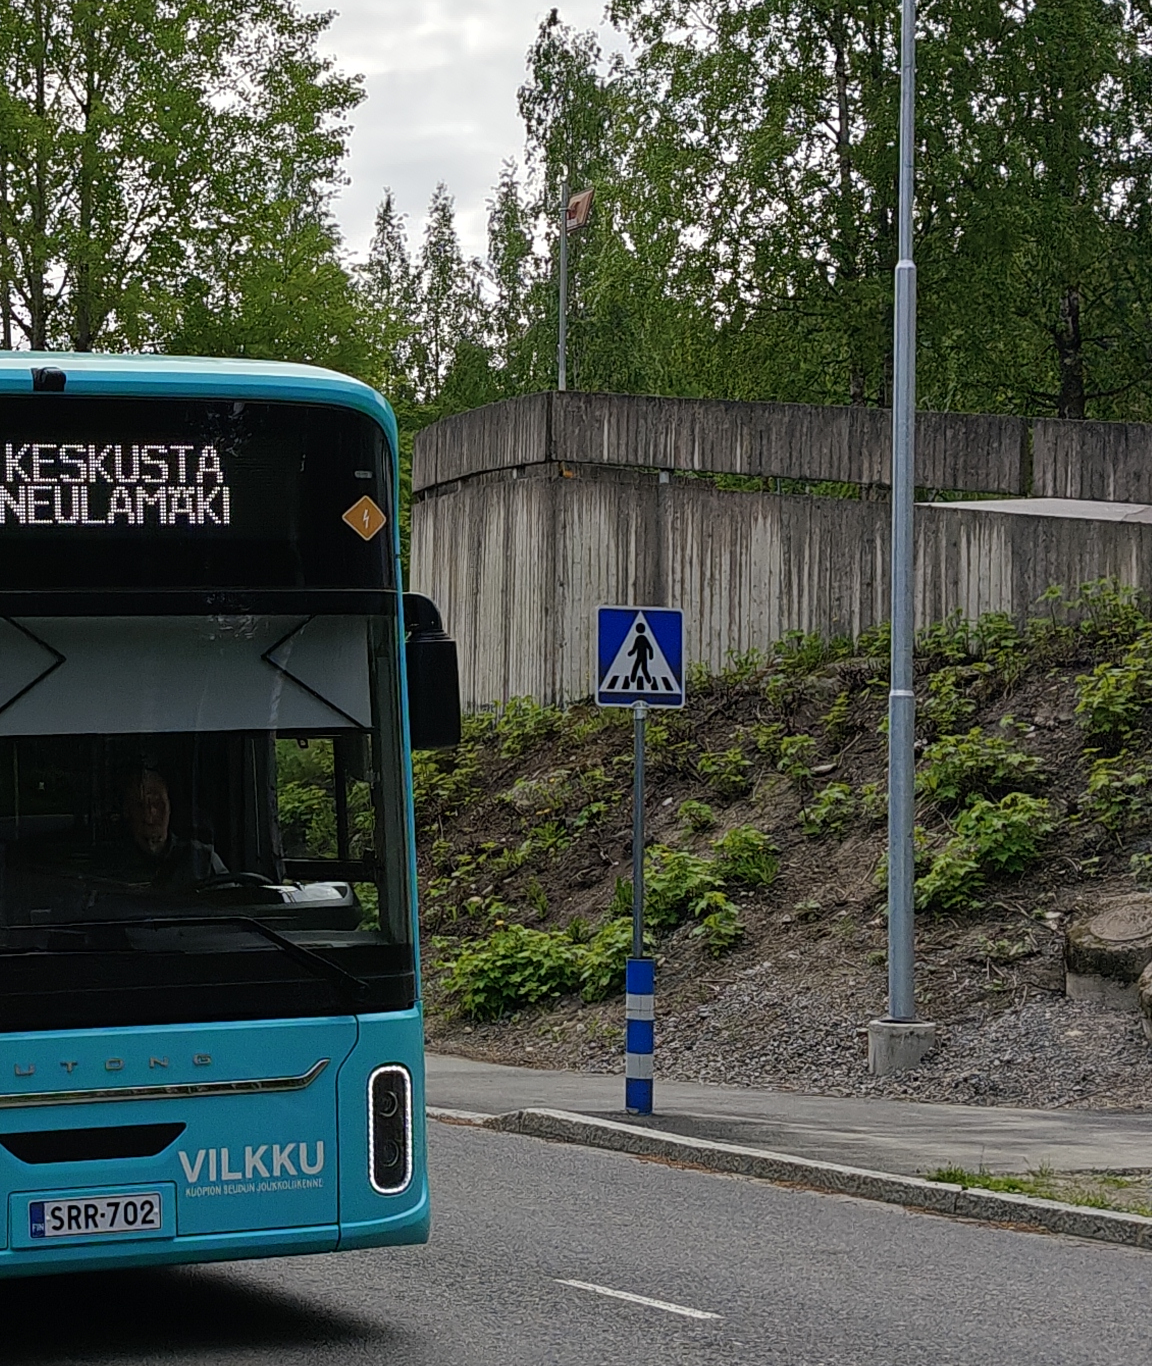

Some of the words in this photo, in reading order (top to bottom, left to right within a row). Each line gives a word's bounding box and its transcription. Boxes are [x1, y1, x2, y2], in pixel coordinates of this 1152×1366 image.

[5, 442, 225, 484] KESKUSTA
[178, 1140, 325, 1184] VILKKU
[185, 1186, 222, 1198] KUOPION
[223, 1183, 256, 1195] SEUDUN
[256, 1178, 324, 1193] JOUKKOLIIKENNE
[32, 1223, 45, 1232] FIN
[50, 1199, 156, 1232] SRR-702
